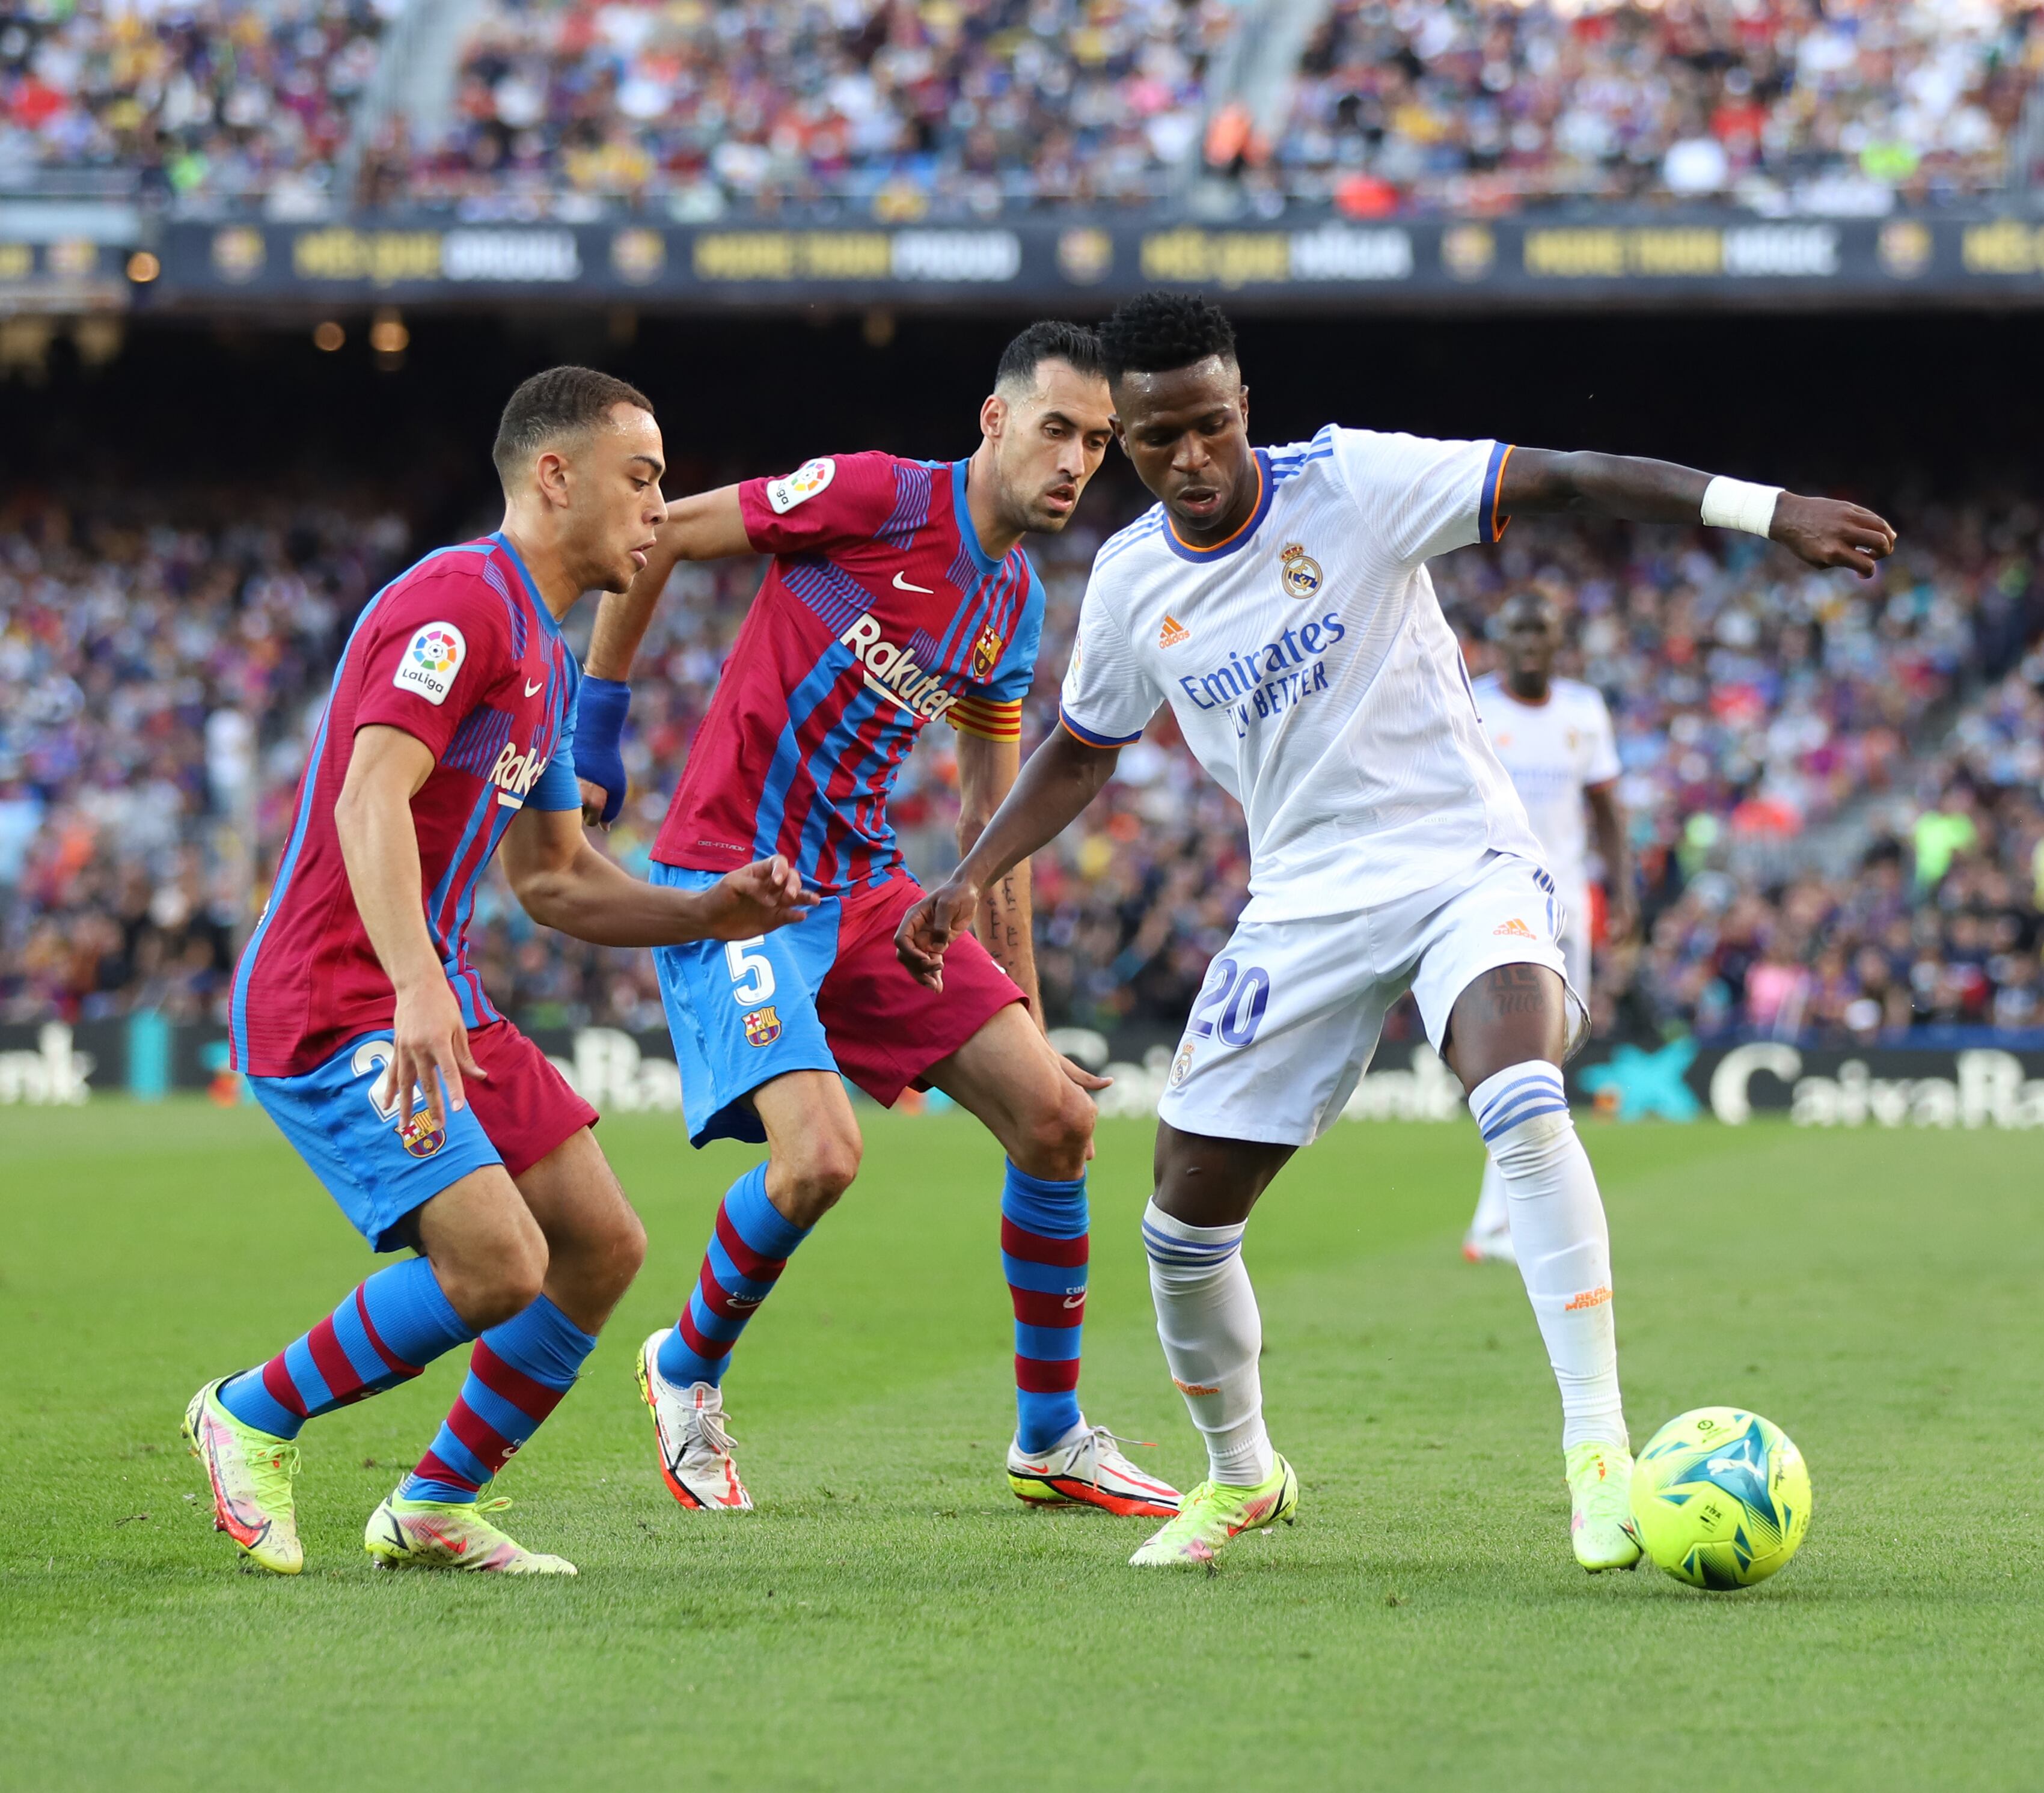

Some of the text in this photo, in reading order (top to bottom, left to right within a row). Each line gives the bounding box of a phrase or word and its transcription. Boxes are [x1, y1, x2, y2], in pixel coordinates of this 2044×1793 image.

[1159, 629, 1190, 650] adidas
[1179, 612, 1345, 710] Emirates
[402, 668, 444, 694] LaLiga
[1252, 661, 1329, 719] BETTER
[1493, 927, 1537, 940] adidas
[724, 935, 776, 1006] 5
[1186, 959, 1270, 1048] 20
[351, 1040, 423, 1123] 2
[414, 1129, 429, 1140] FCB
